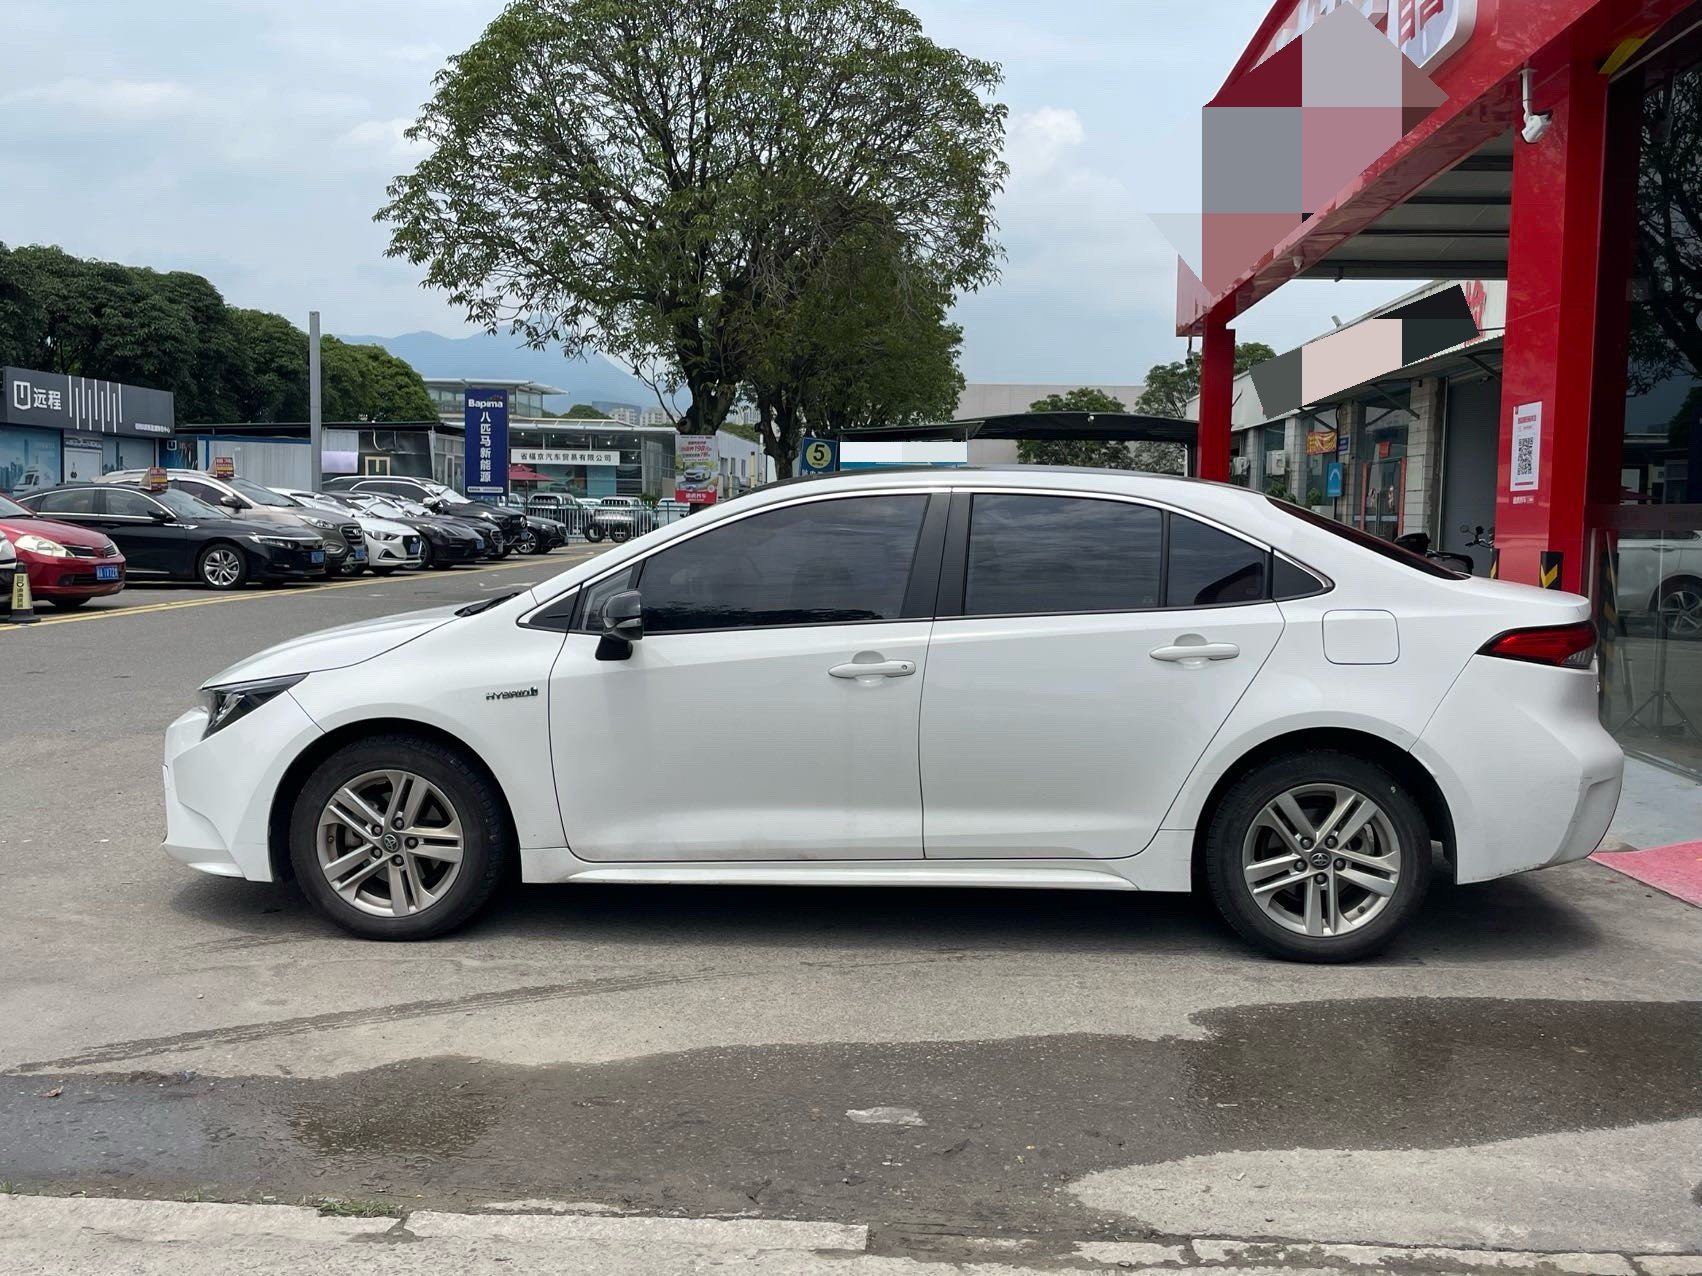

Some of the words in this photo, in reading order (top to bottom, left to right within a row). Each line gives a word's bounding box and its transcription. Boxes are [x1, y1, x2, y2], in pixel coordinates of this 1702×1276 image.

[33, 387, 62, 410] 远程
[468, 399, 503, 409] Bapima
[480, 411, 491, 483] 八匹马新能源
[813, 444, 825, 462] 5
[486, 689, 530, 700] HYBRID
